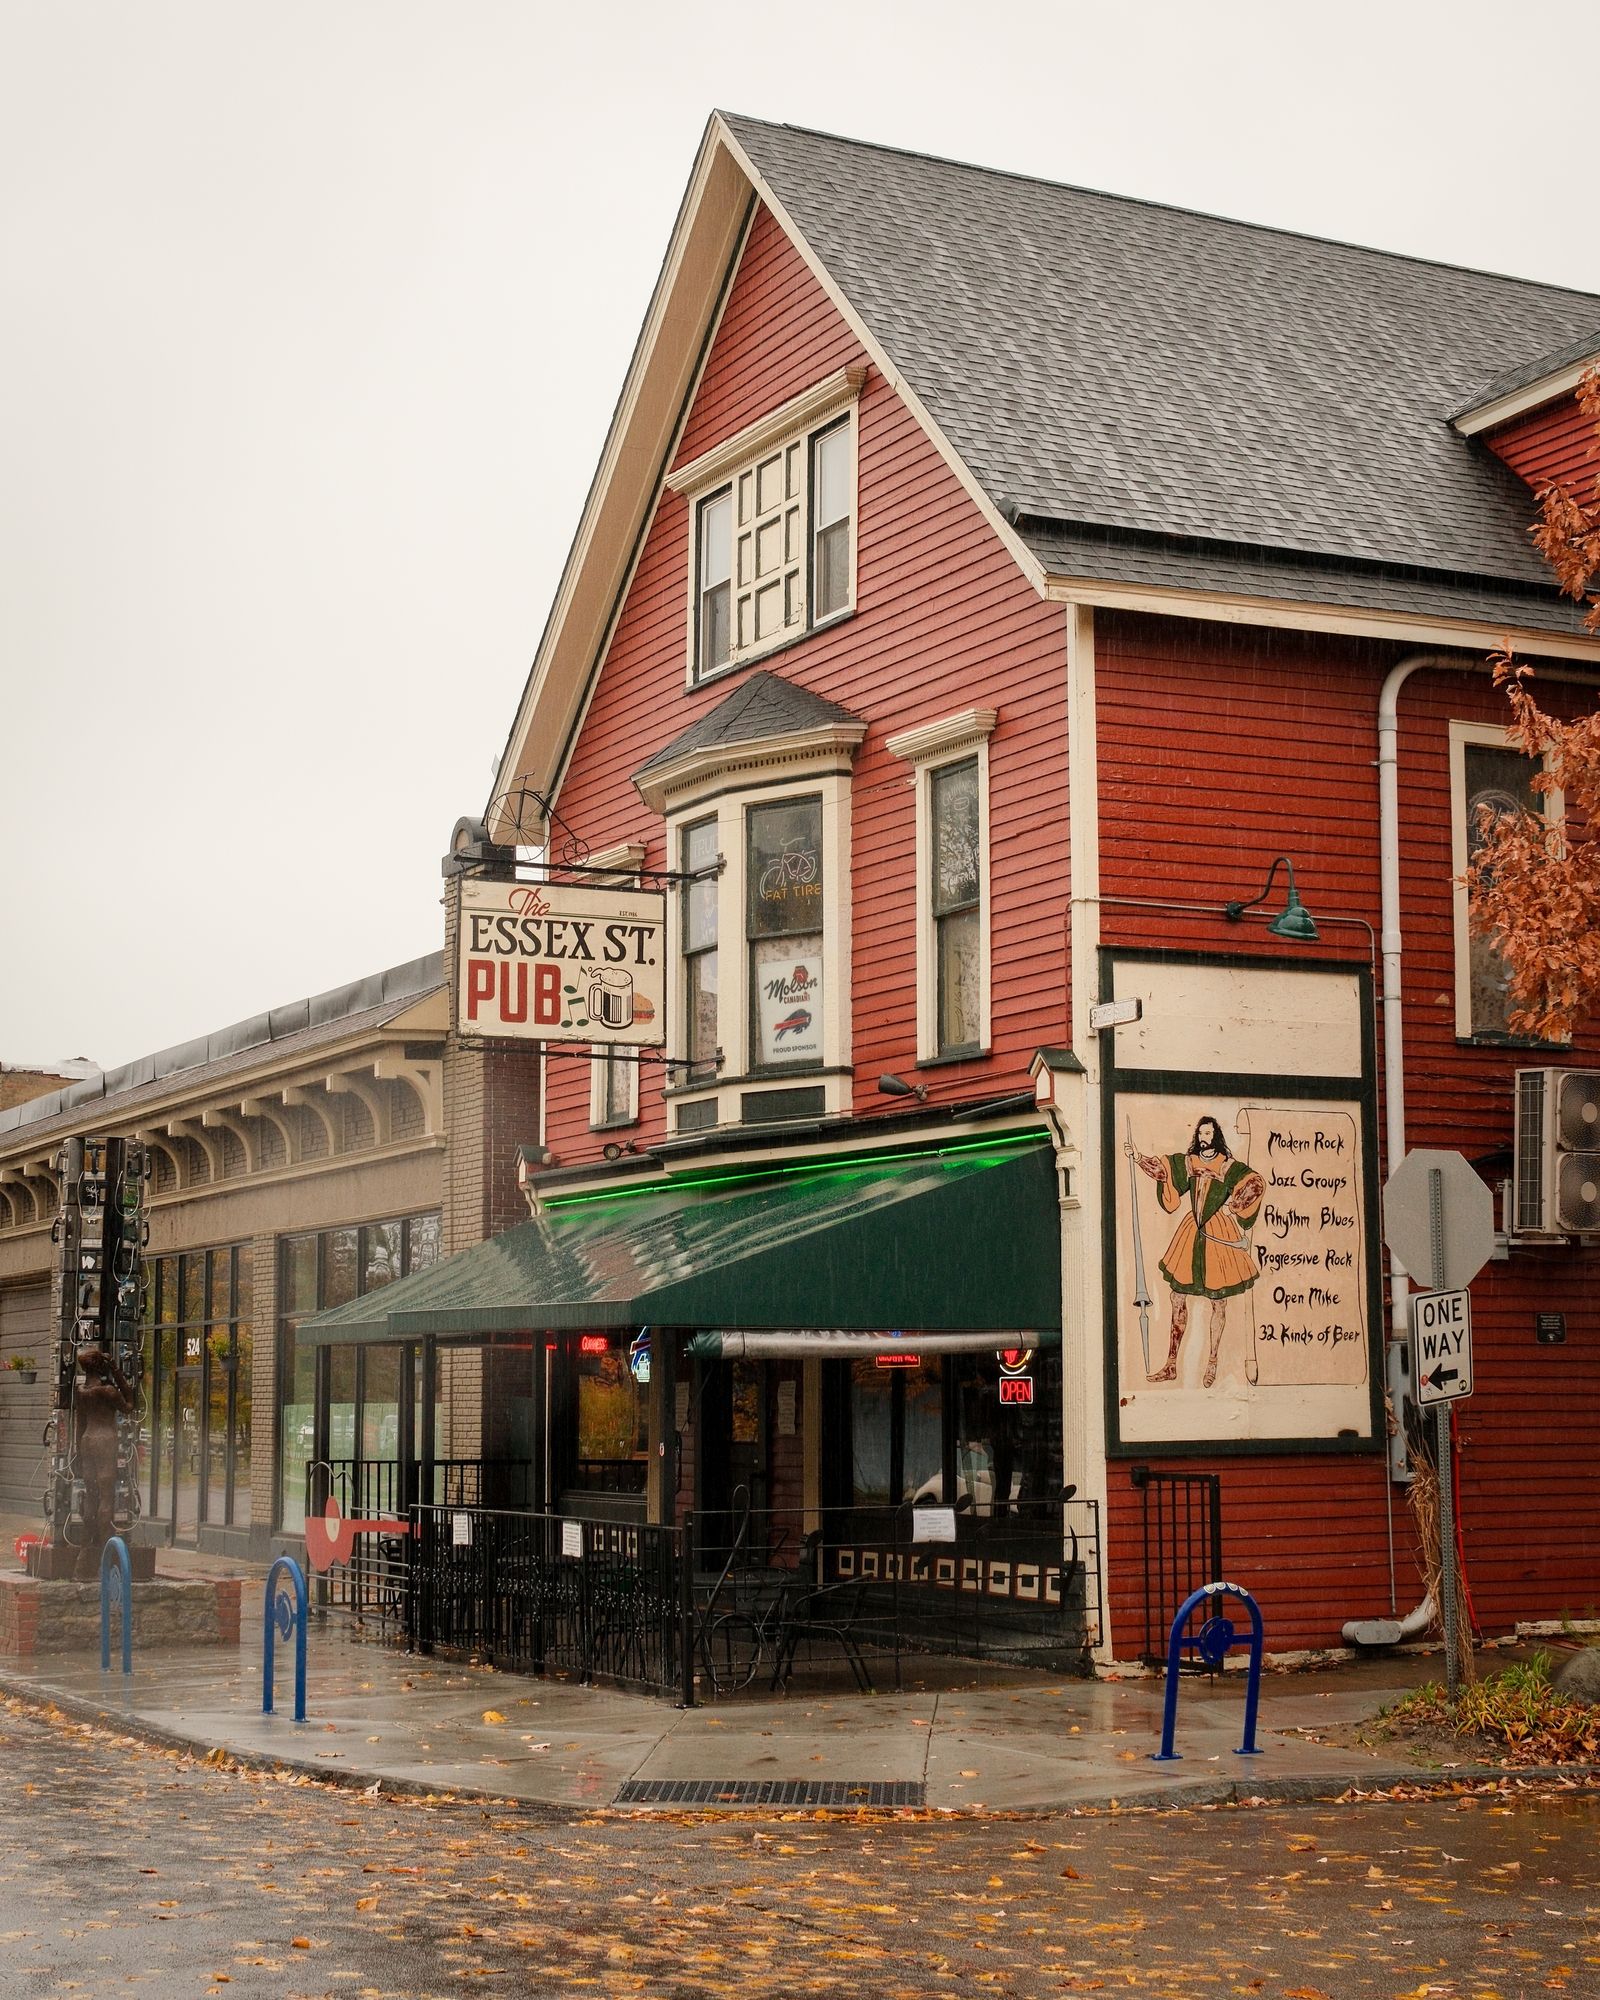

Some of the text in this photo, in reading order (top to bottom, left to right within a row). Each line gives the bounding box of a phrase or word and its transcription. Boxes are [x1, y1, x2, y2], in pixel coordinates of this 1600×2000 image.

[508, 887, 551, 917] The
[765, 883, 822, 901] FAT TIRE
[469, 914, 656, 966] ESSEX ST.
[467, 959, 562, 1025] PUB
[763, 977, 818, 1003] Molson
[772, 1043, 817, 1054] PROUD SPONSOR
[1268, 1131, 1345, 1157] Modern Rock
[1268, 1169, 1347, 1198] Jazz Groups
[1264, 1205, 1354, 1238] Rhythm Blues
[1255, 1245, 1353, 1274] Progressive Rock
[1273, 1286, 1341, 1312] Open Mike
[1423, 1297, 1464, 1328] ONE
[186, 1337, 200, 1356] 524
[1258, 1324, 1360, 1350] 32 Kinds of Beer
[1422, 1328, 1465, 1360] WAY
[1001, 1380, 1031, 1402] OPEN
